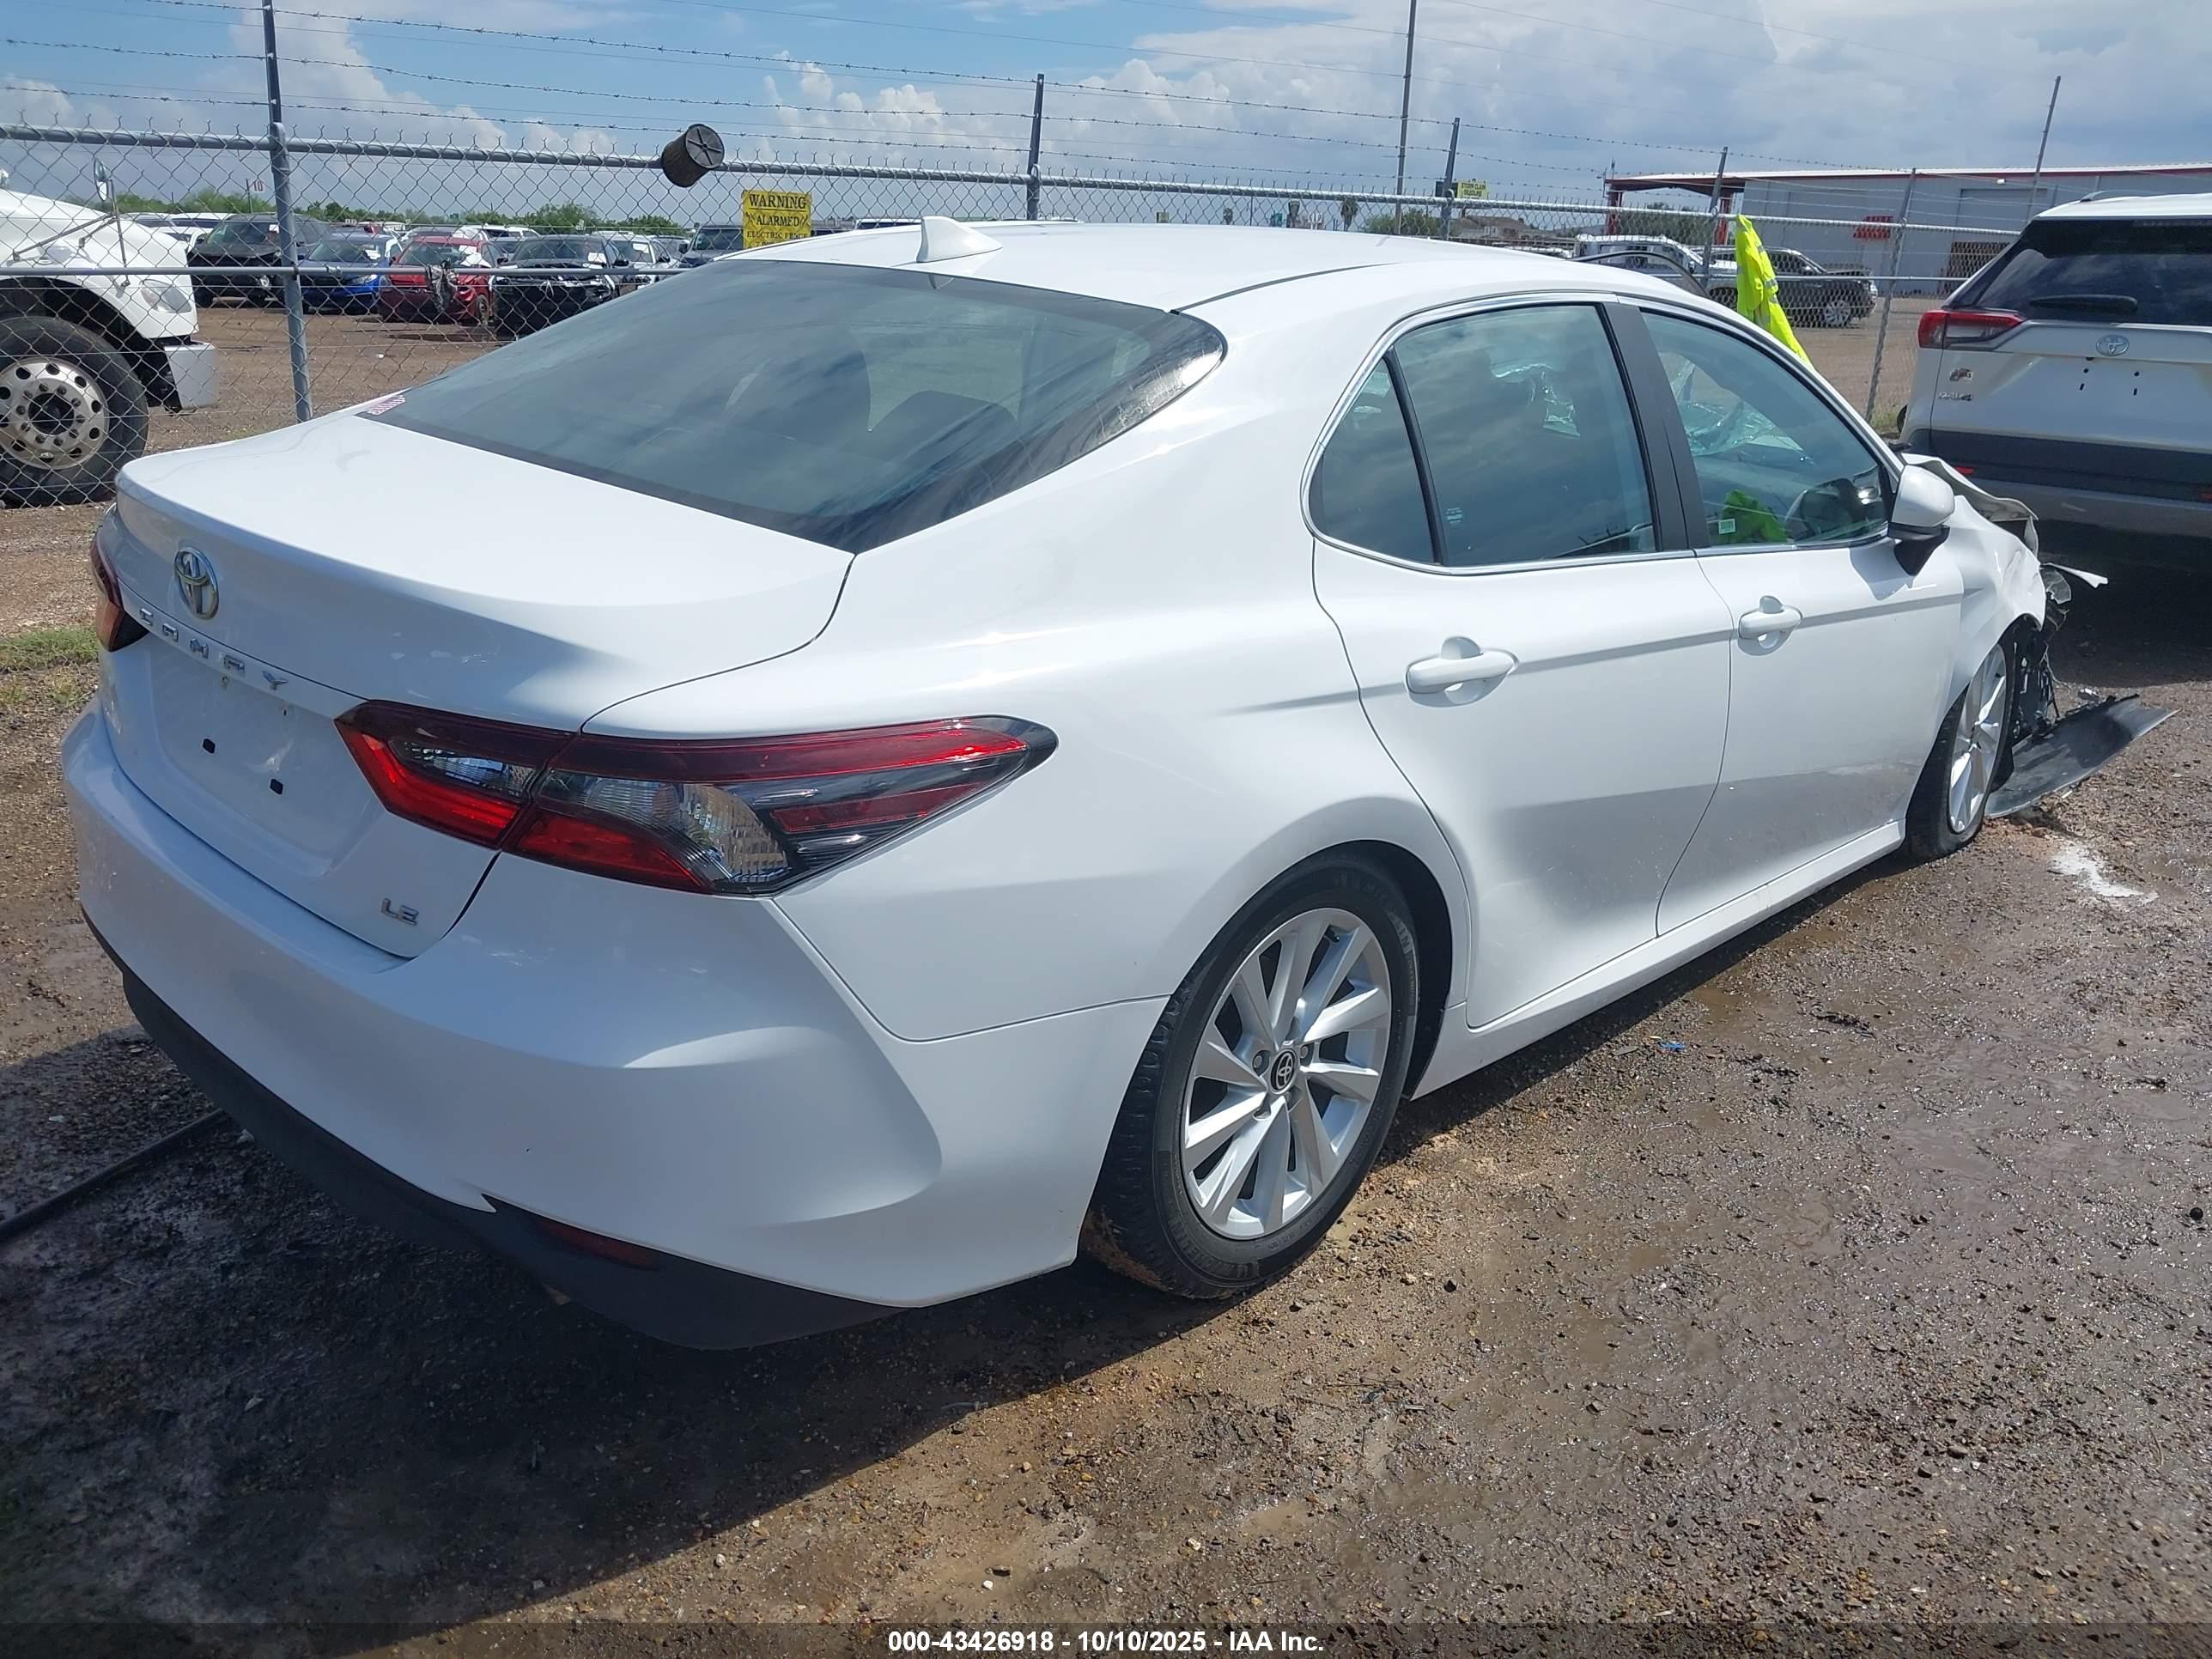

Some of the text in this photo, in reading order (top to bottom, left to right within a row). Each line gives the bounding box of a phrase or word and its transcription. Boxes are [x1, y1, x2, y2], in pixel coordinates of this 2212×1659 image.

[749, 193, 807, 210] WARNING
[756, 214, 799, 227] ALARMED
[746, 230, 783, 239] ELECTRIC
[139, 607, 290, 691] CAMRY
[380, 897, 420, 927] LE
